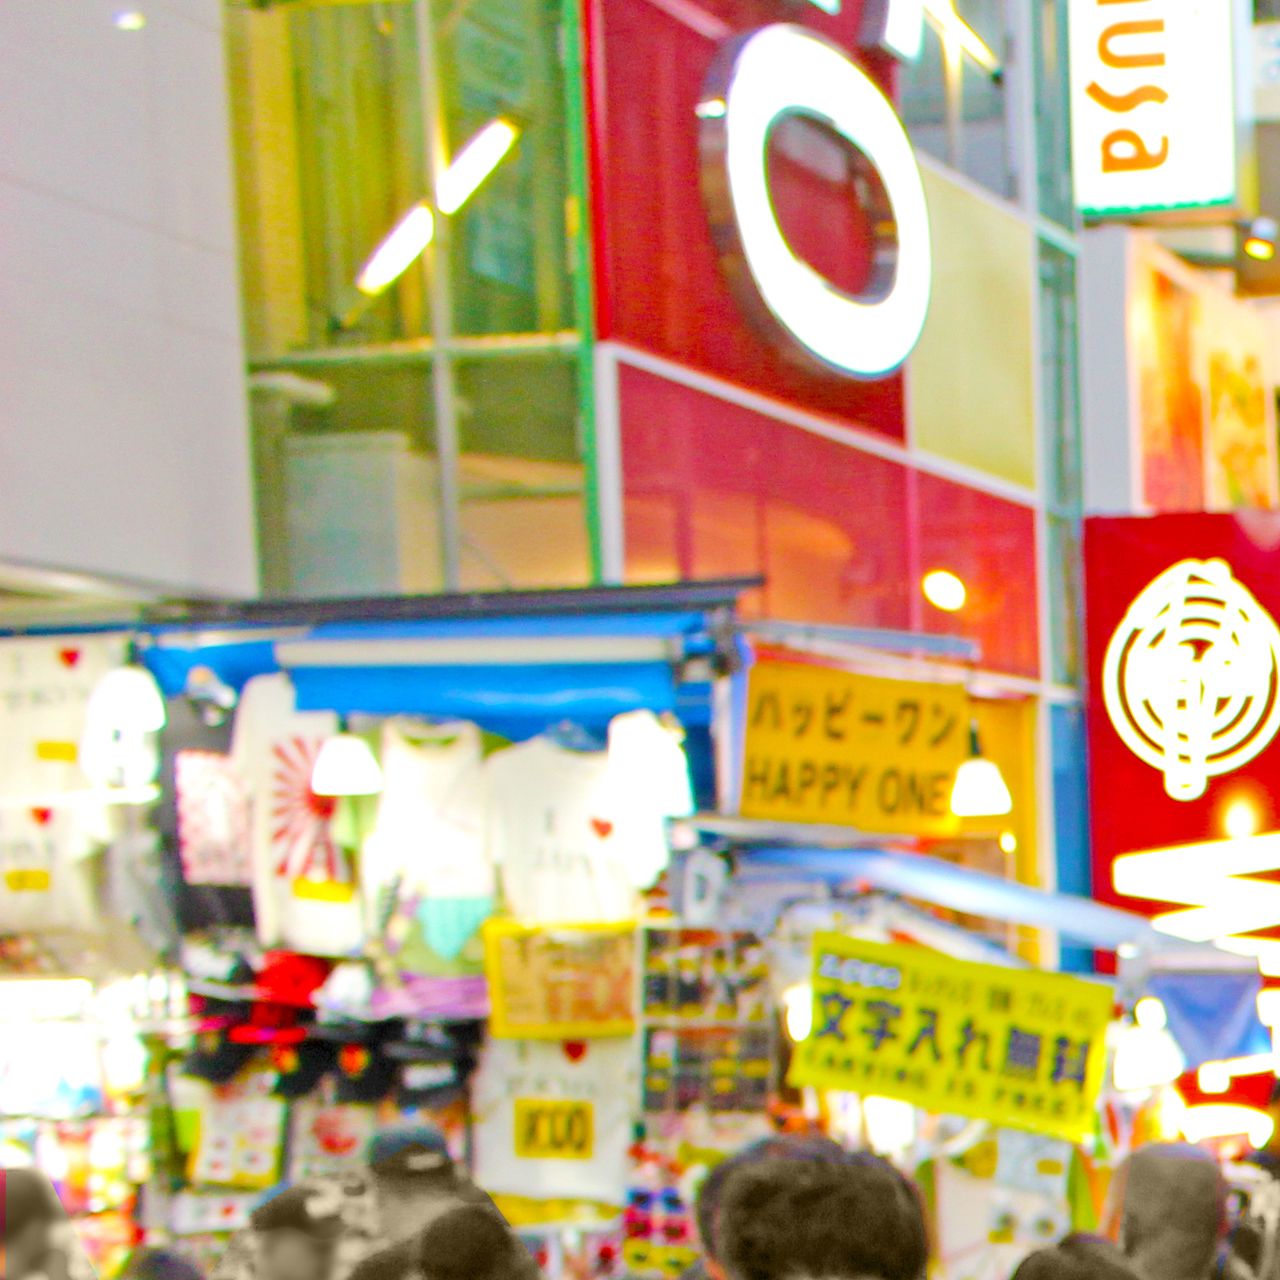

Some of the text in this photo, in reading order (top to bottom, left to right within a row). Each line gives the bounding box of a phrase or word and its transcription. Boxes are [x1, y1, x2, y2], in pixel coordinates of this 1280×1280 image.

[1085, 0, 1169, 174] usa
[752, 690, 958, 747] ハッピーワン
[749, 757, 950, 816] HAPPY ONE
